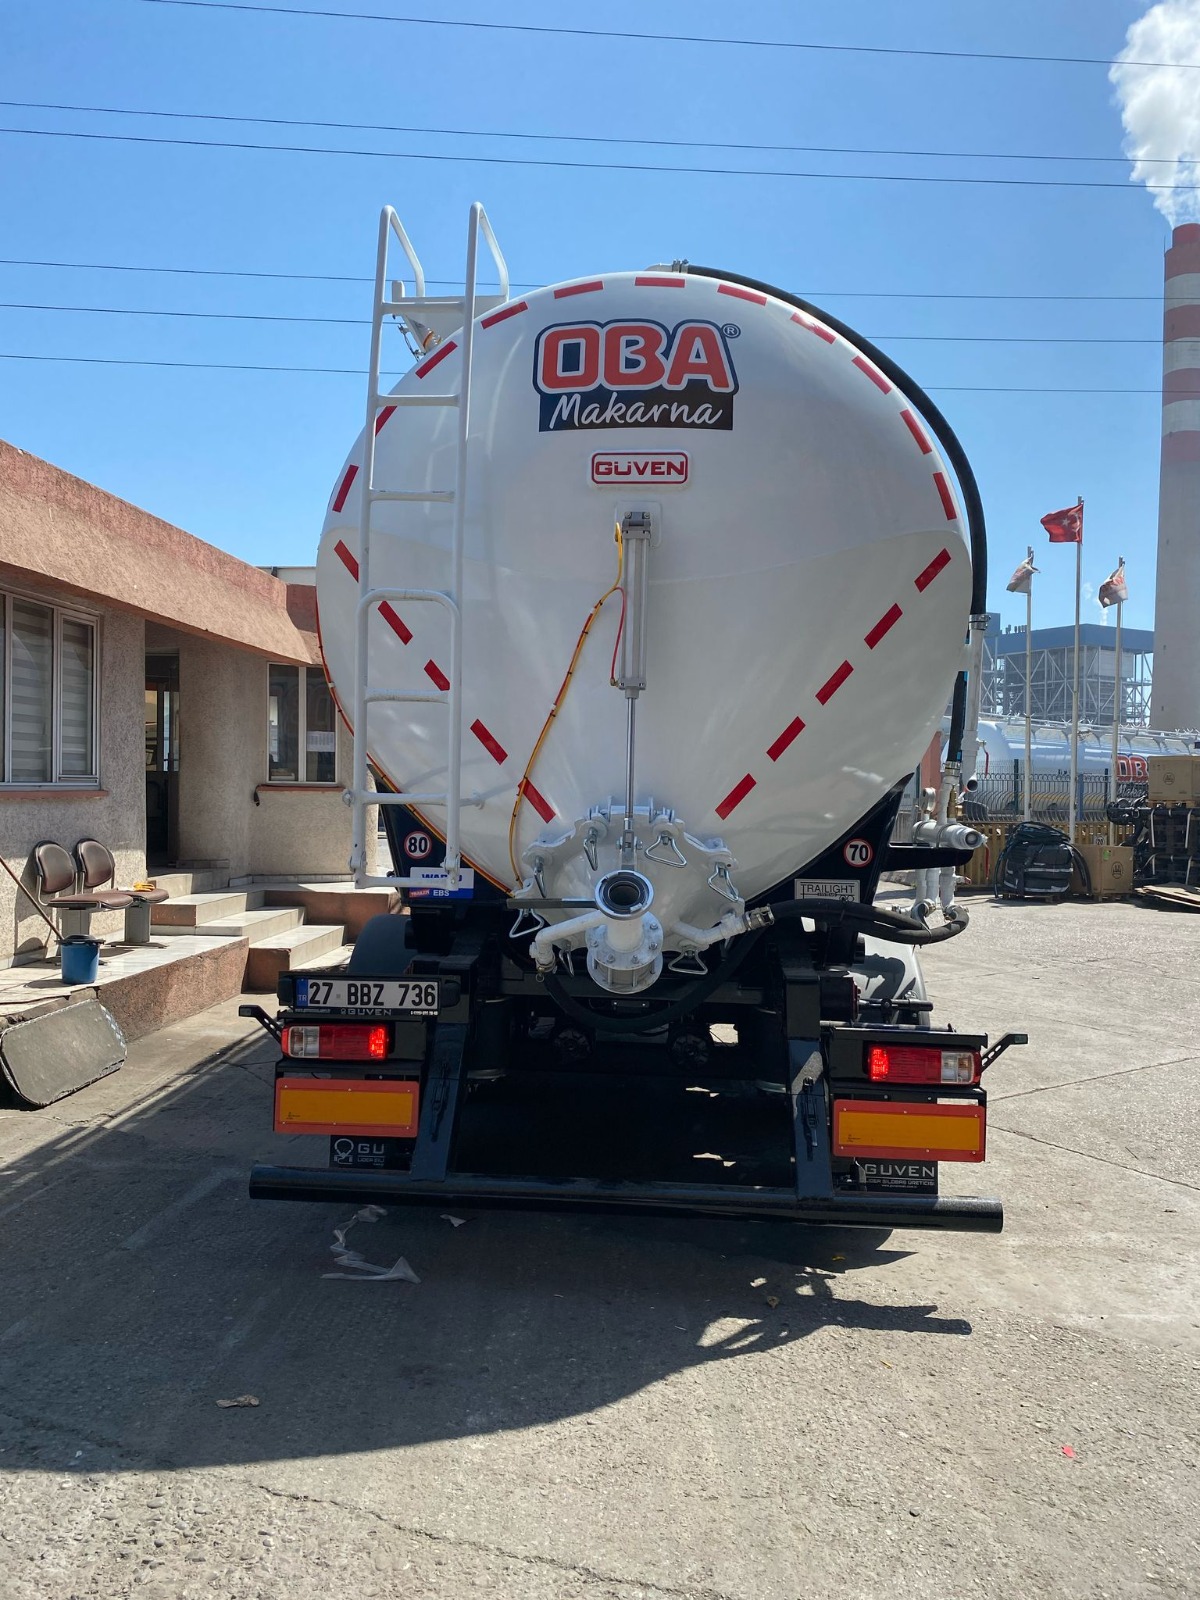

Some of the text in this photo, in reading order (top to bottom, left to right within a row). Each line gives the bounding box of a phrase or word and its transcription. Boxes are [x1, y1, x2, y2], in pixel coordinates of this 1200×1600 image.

[537, 322, 734, 393] OBA
[549, 391, 723, 430] Makarna
[594, 460, 685, 476] GÜVEN
[1115, 754, 1149, 783] OB
[408, 836, 428, 854] 80
[849, 844, 869, 861] 70
[433, 889, 450, 897] EBS
[800, 884, 855, 895] TRAILIGHT
[309, 982, 333, 1005] 27
[347, 983, 384, 1006] BBZ
[398, 983, 436, 1007] 736
[358, 1143, 385, 1154] GU
